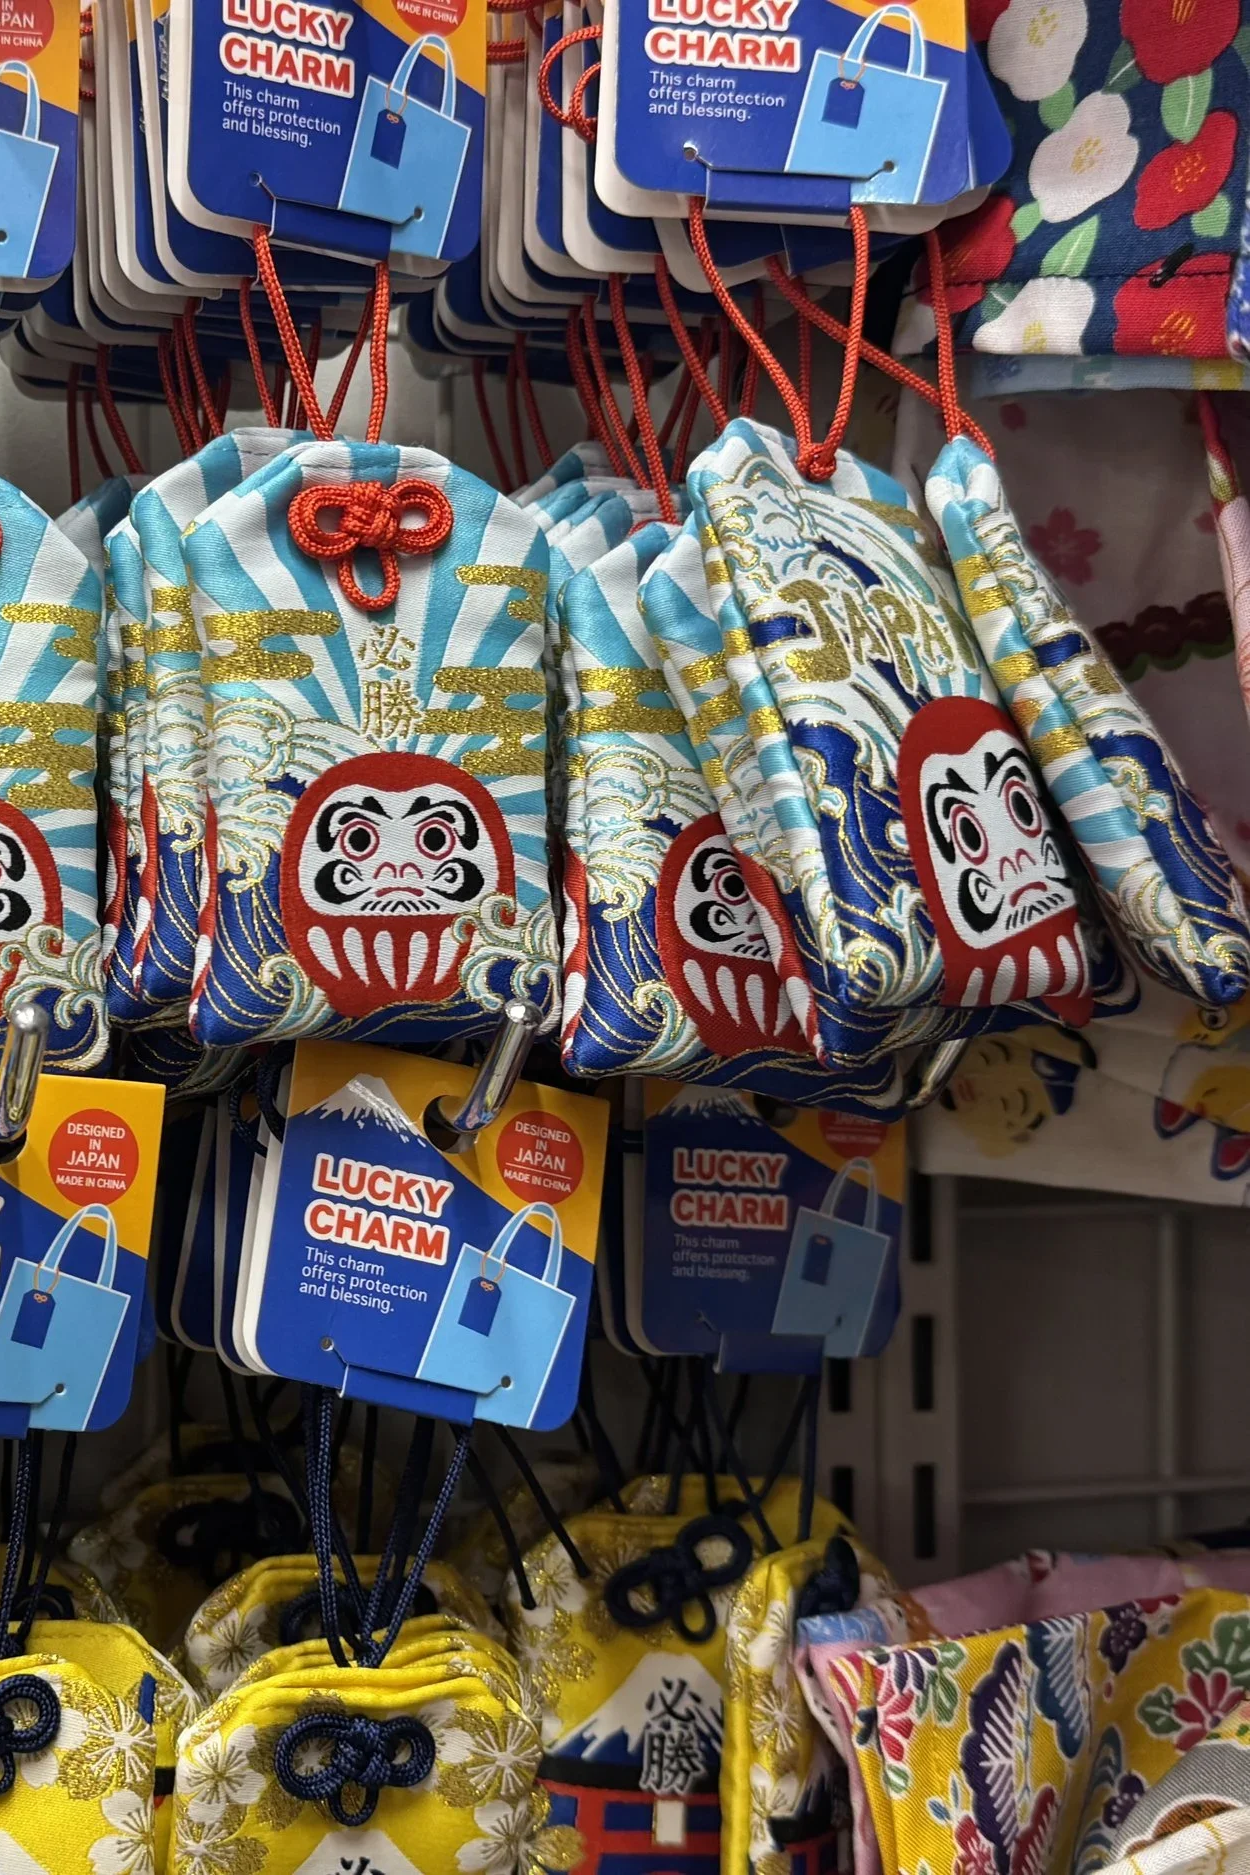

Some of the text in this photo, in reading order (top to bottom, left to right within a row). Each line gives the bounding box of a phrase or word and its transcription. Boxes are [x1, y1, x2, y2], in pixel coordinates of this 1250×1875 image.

[228, 0, 349, 45] LUCKY
[396, 1, 458, 25] MADE IN CHINA
[654, 0, 792, 26] LUCKY
[0, 34, 11, 45] IN
[12, 36, 43, 48] CHINA
[650, 32, 795, 68] CHARM
[225, 37, 350, 93] CHARM
[650, 70, 736, 90] This charm
[223, 81, 299, 110] This charm
[649, 87, 785, 108] offers protection
[222, 100, 341, 136] offers protection
[648, 102, 751, 122] and blessing.
[222, 117, 312, 147] and blessing.
[357, 625, 424, 739] 必勝
[67, 1122, 126, 1140] DESIGNED
[514, 1121, 571, 1144] DESIGNED
[89, 1139, 101, 1150] IN
[535, 1139, 548, 1151] IN
[66, 1150, 120, 1169] JAPAN
[514, 1148, 566, 1172] JAPAN
[676, 1151, 785, 1185] LUCKY
[56, 1174, 126, 1190] MADE IN CHINA
[317, 1159, 450, 1213] LUCKY
[503, 1169, 572, 1194] MADE IN CHINA
[674, 1195, 784, 1227] CHARM
[309, 1204, 445, 1260] CHARM
[674, 1234, 740, 1249] This charm
[305, 1246, 385, 1276] This charm
[672, 1249, 776, 1267] offers protection
[301, 1264, 428, 1302] offers protection
[672, 1265, 749, 1282] and blessing.
[299, 1281, 395, 1314] and blessing.
[641, 1677, 707, 1795] 必勝
